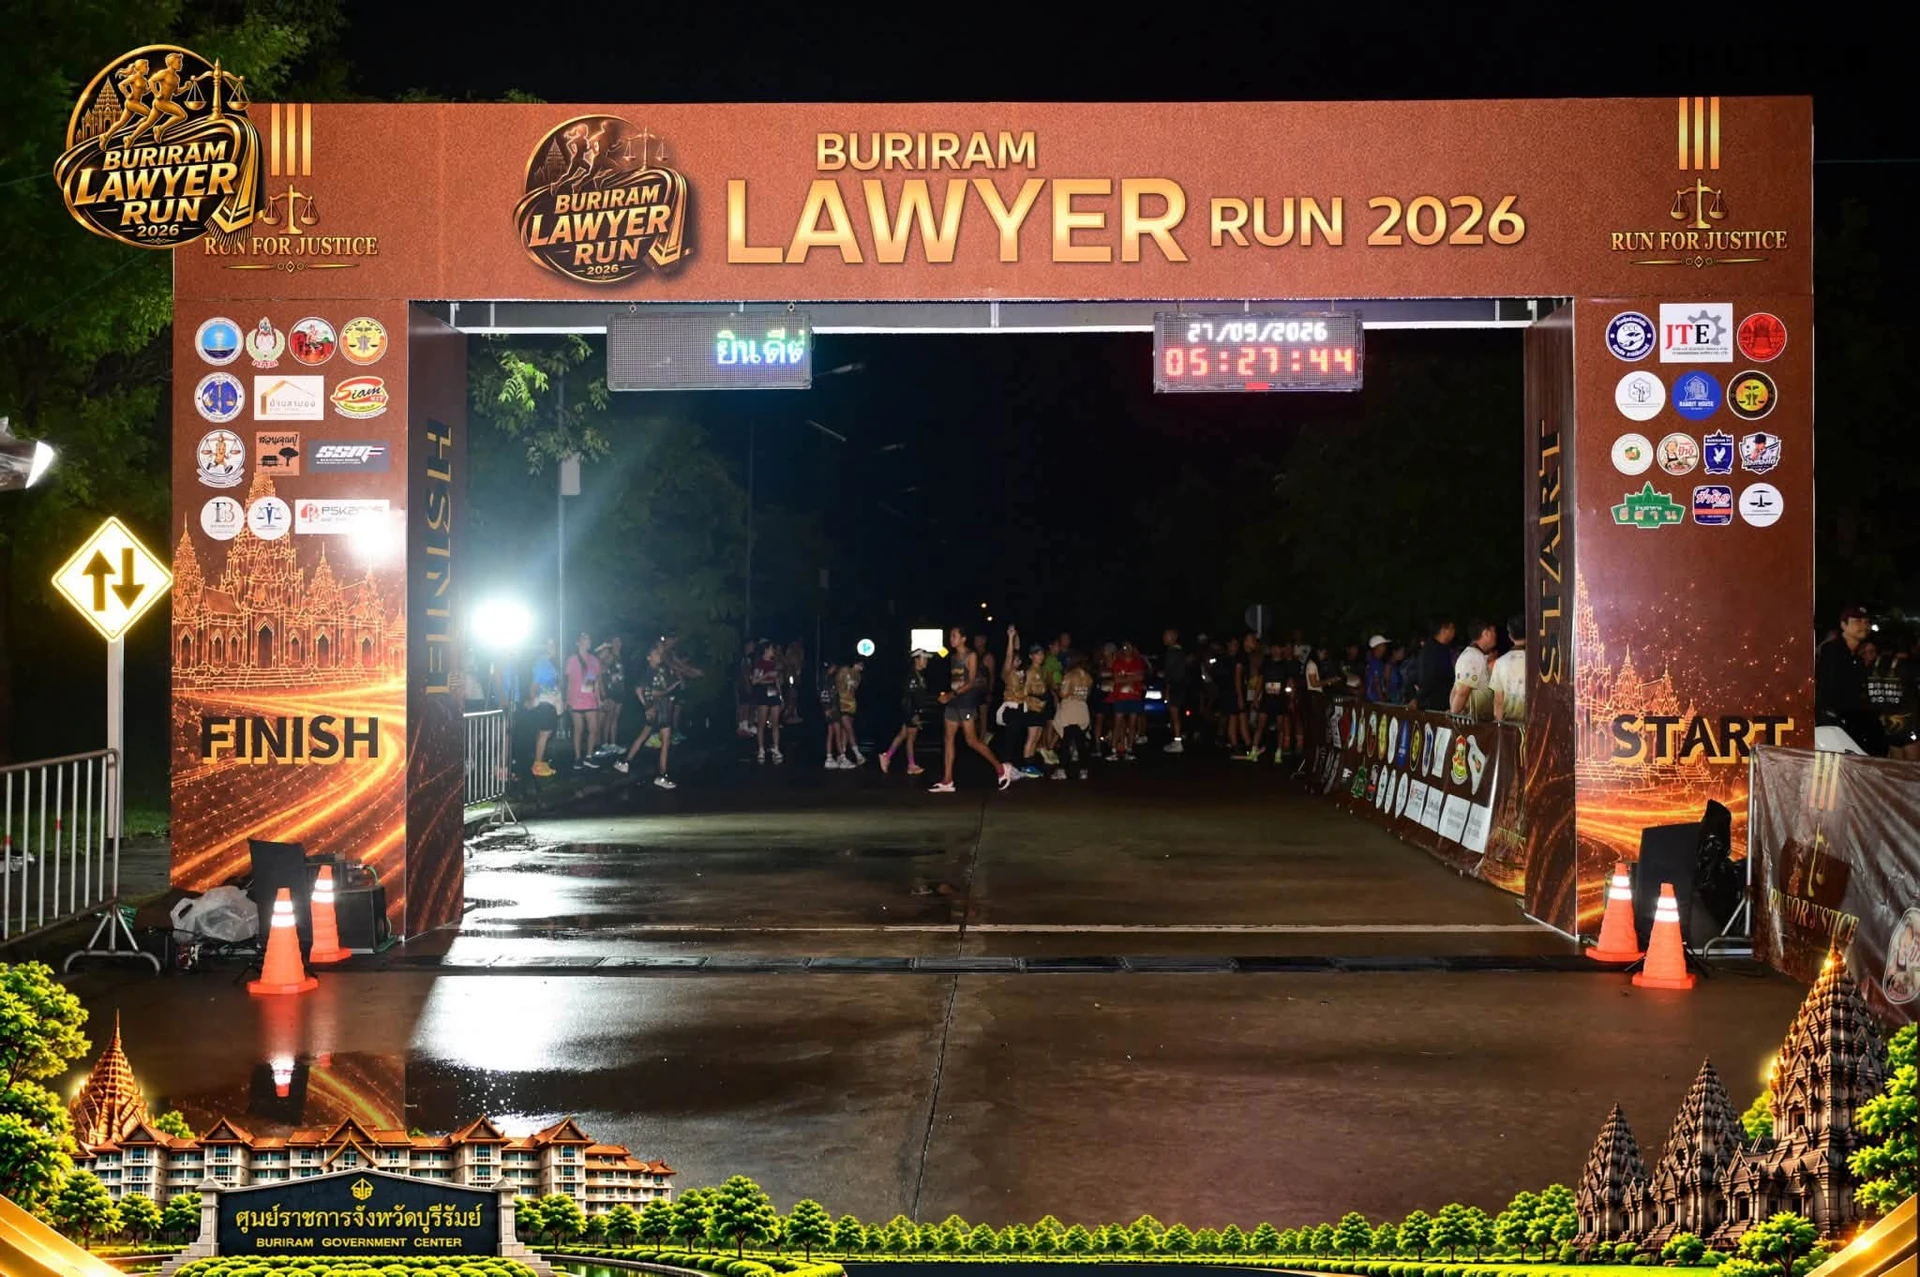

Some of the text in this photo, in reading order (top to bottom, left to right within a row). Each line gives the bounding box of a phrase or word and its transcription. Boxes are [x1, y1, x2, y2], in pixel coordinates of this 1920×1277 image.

[816, 130, 1037, 171] BURIRAM
[554, 183, 662, 215] BURIRAM
[527, 204, 673, 248] LAWYER
[726, 177, 1527, 264] LAWYER RUN 2026
[252, 236, 295, 256] FOR
[295, 236, 378, 256] JUSTICE
[573, 237, 643, 266] RUN
[1611, 230, 1787, 252] RUN FOR JUSTICE
[586, 264, 619, 276] 2026
[1665, 324, 1710, 349] JTE
[1165, 347, 1355, 376] 05:27:44
[331, 377, 384, 402] Siam
[425, 418, 453, 694] FINISH
[1539, 419, 1561, 686] START
[201, 714, 381, 765] FINISH
[1611, 714, 1794, 764] START
